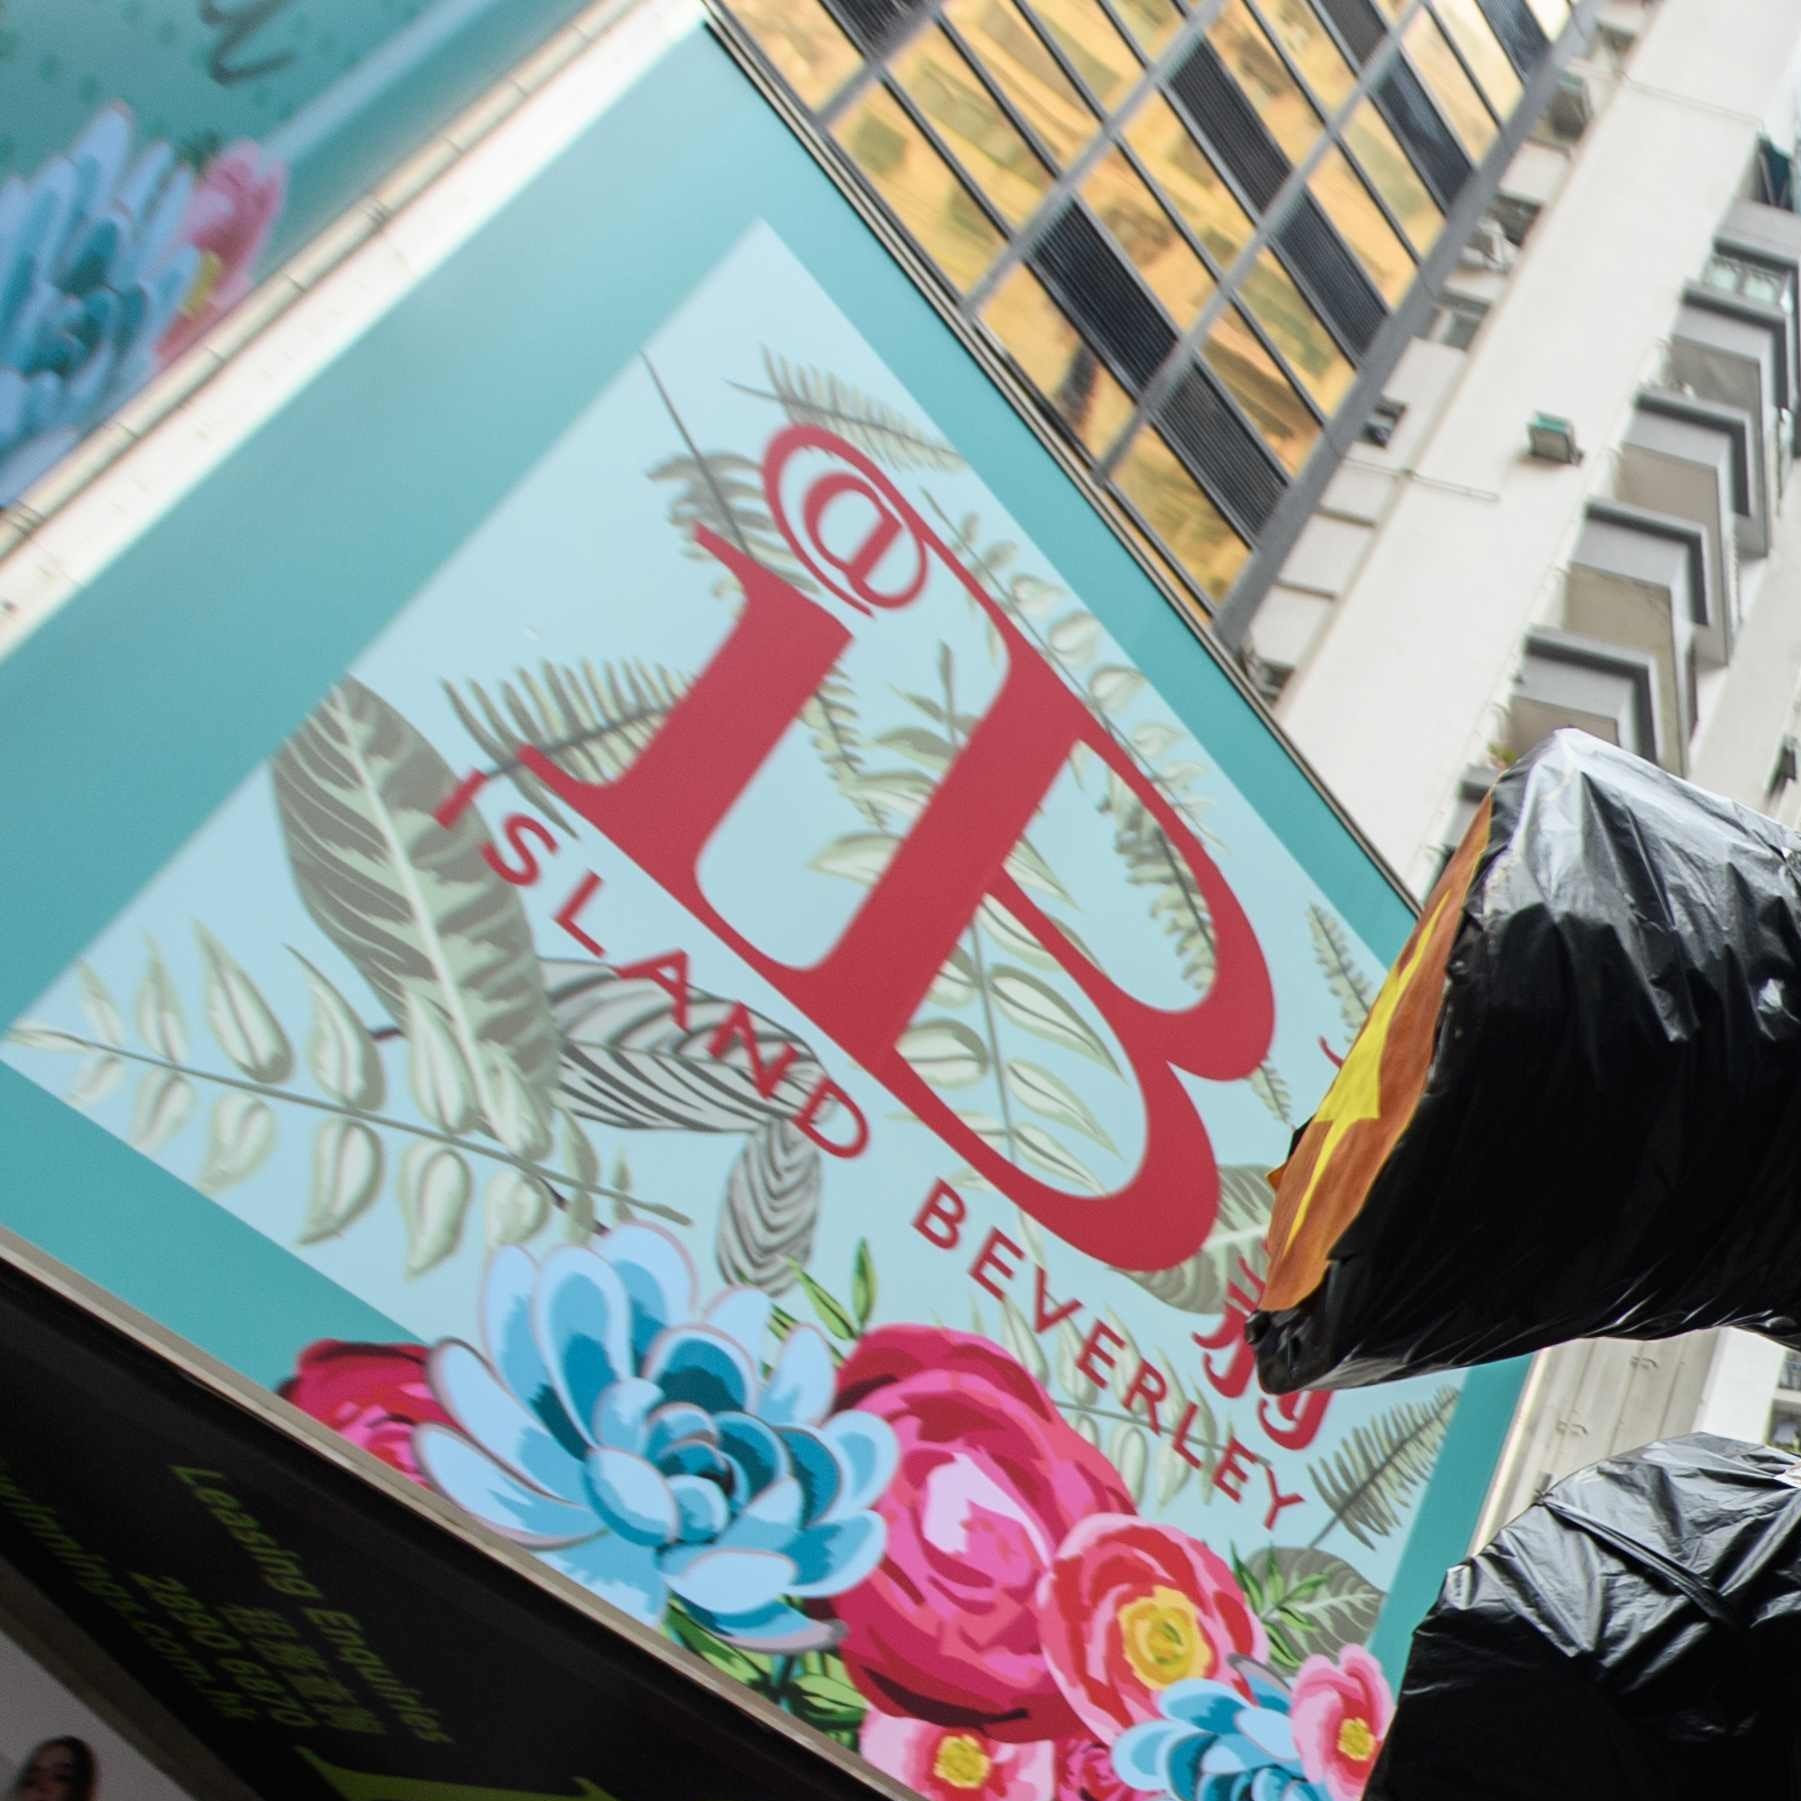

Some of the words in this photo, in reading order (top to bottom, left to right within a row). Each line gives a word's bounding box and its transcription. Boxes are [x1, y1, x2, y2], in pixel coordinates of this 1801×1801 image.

[434, 768, 870, 1158] ISLAND
[911, 1179, 1305, 1530] BEVERLEY
[167, 1464, 324, 1600] Leasing
[300, 1606, 455, 1744] Enquiries
